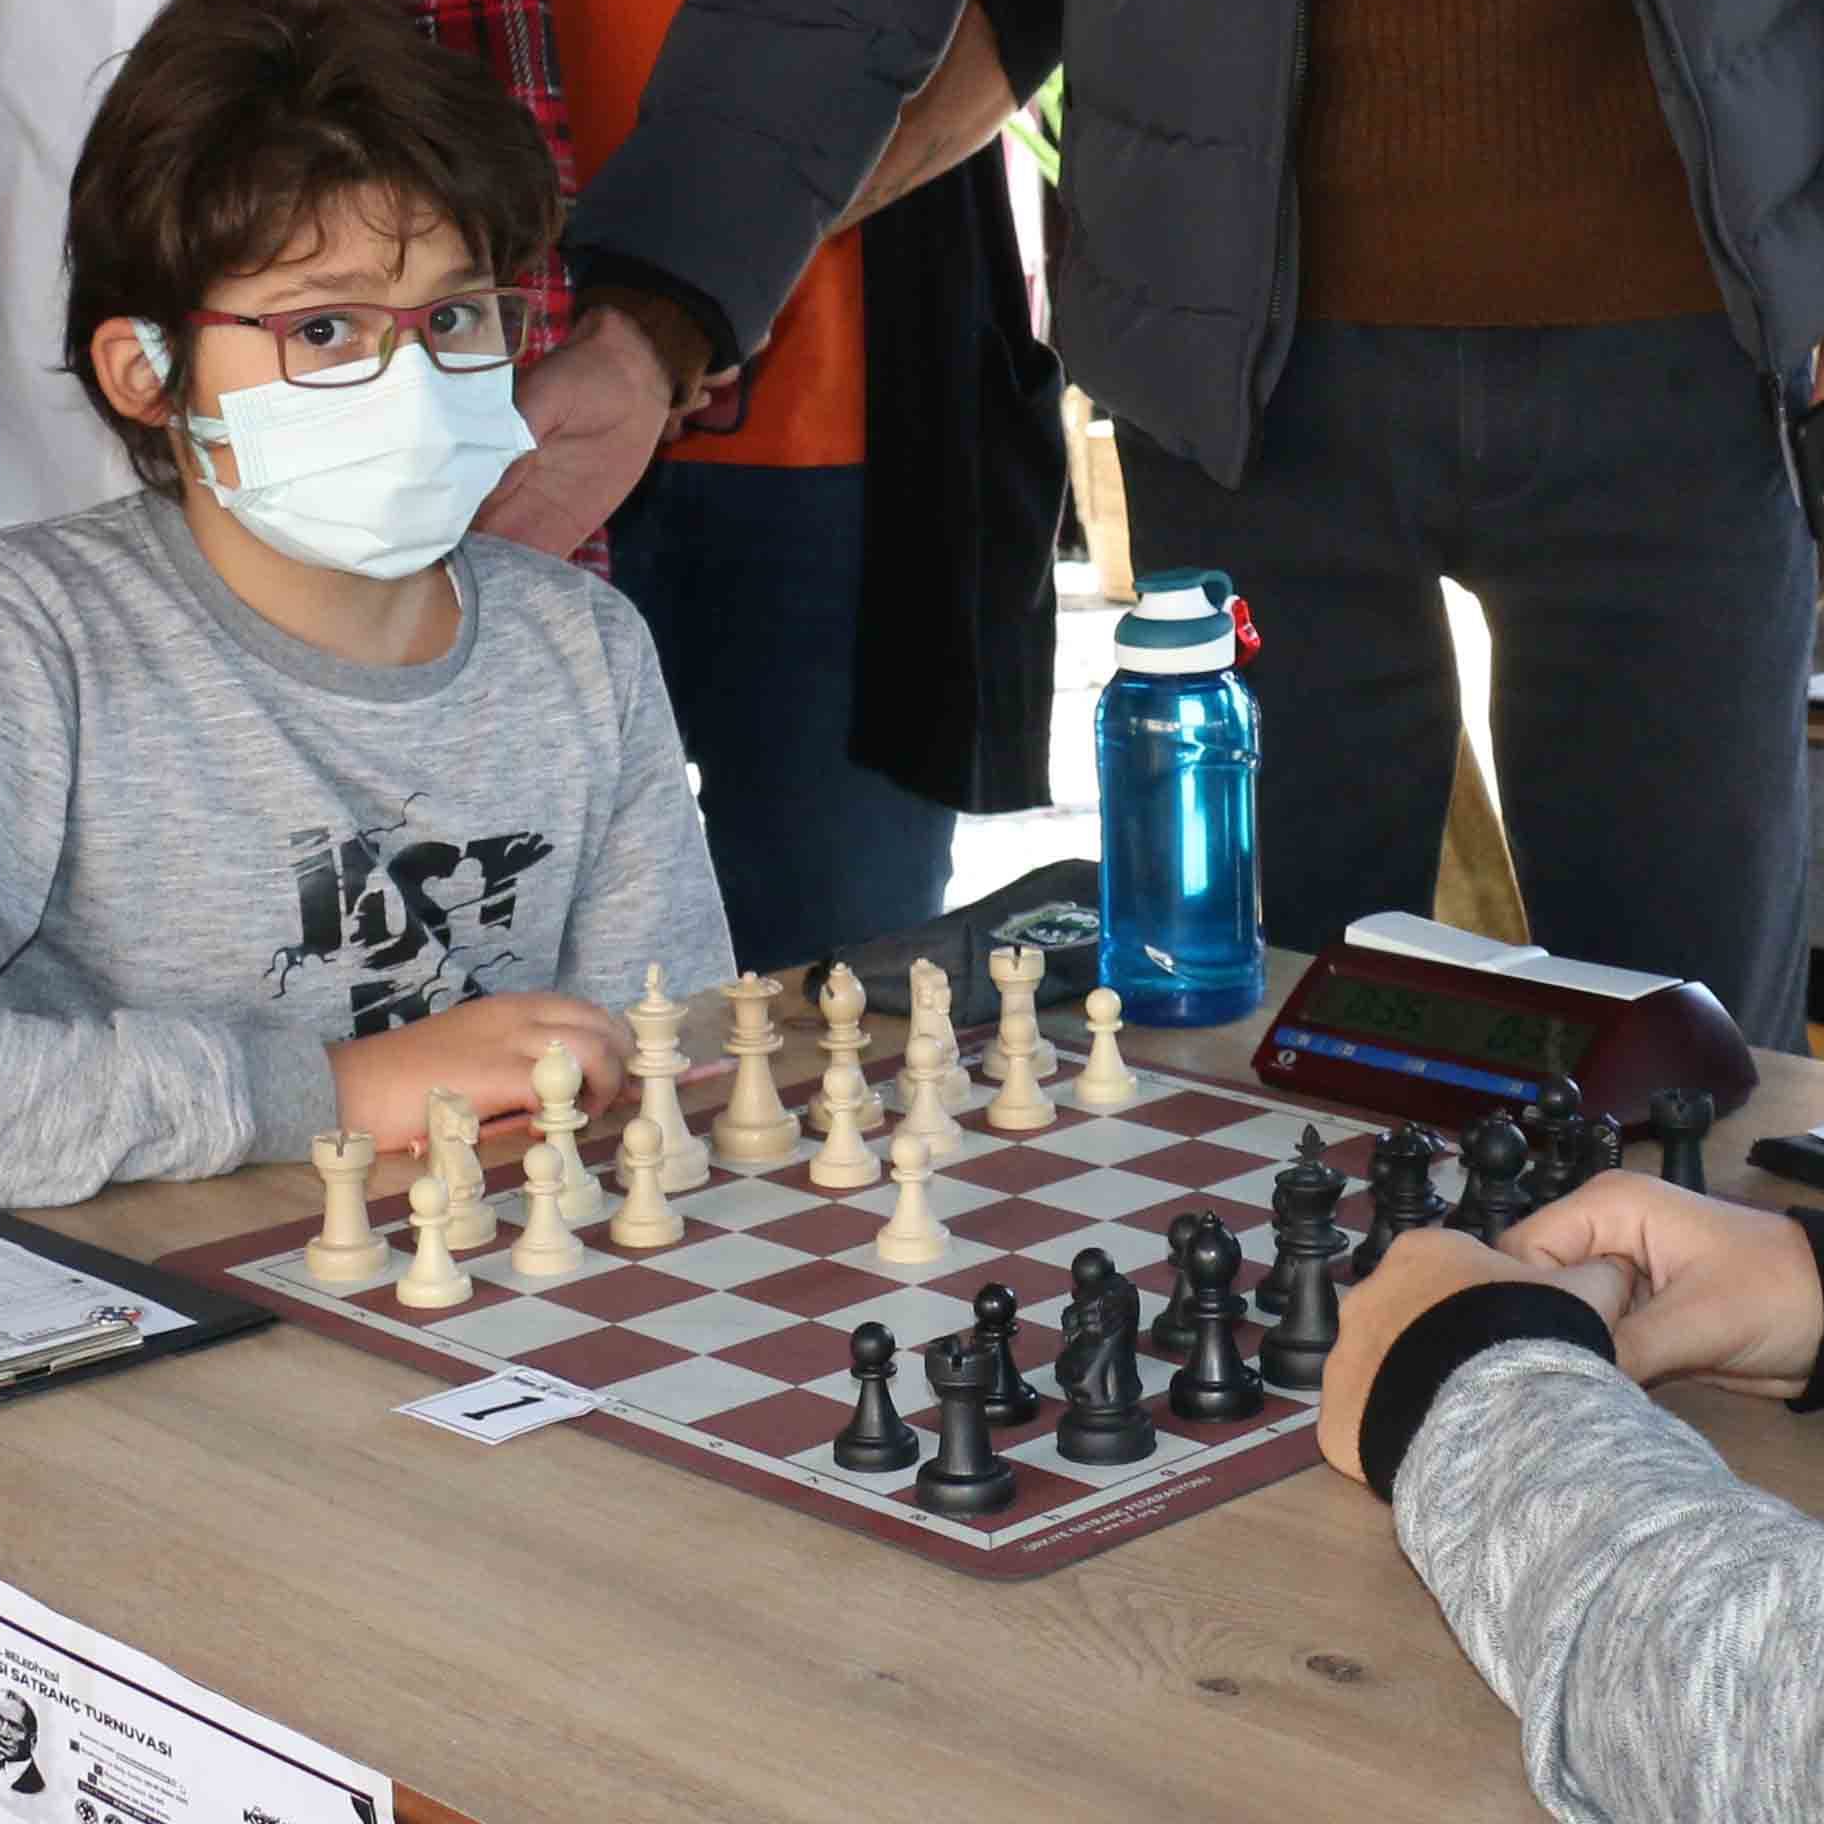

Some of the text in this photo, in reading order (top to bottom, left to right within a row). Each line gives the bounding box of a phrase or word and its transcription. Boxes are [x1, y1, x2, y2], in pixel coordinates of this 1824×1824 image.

[4, 1647, 60, 1683] BELEDİYESİ
[10, 1668, 81, 1715] SATRANÇ
[83, 1703, 173, 1758] TURNUVASI
